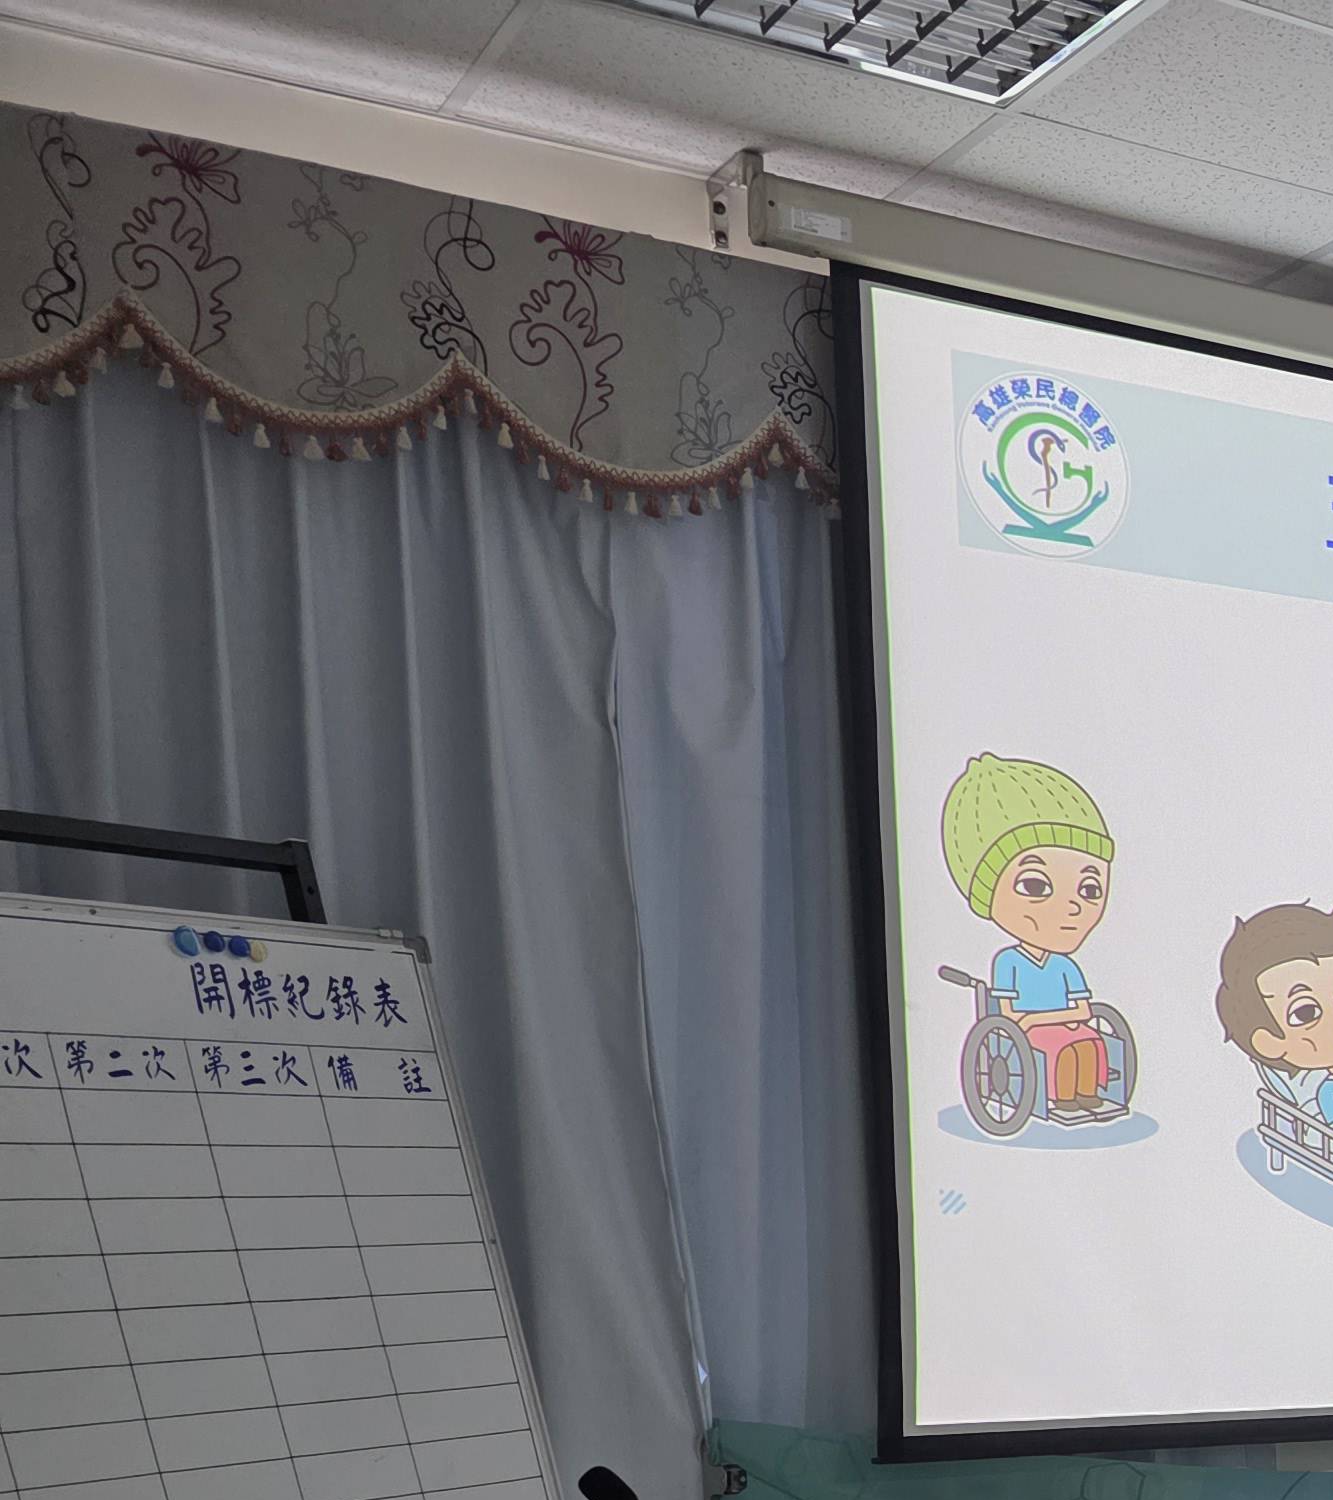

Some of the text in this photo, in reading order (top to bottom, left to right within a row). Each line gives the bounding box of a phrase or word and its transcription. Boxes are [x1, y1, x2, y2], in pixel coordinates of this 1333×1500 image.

[190, 962, 408, 1028] 開標紀錄表
[65, 1040, 177, 1085] 第二次
[201, 1045, 309, 1089] 第三次
